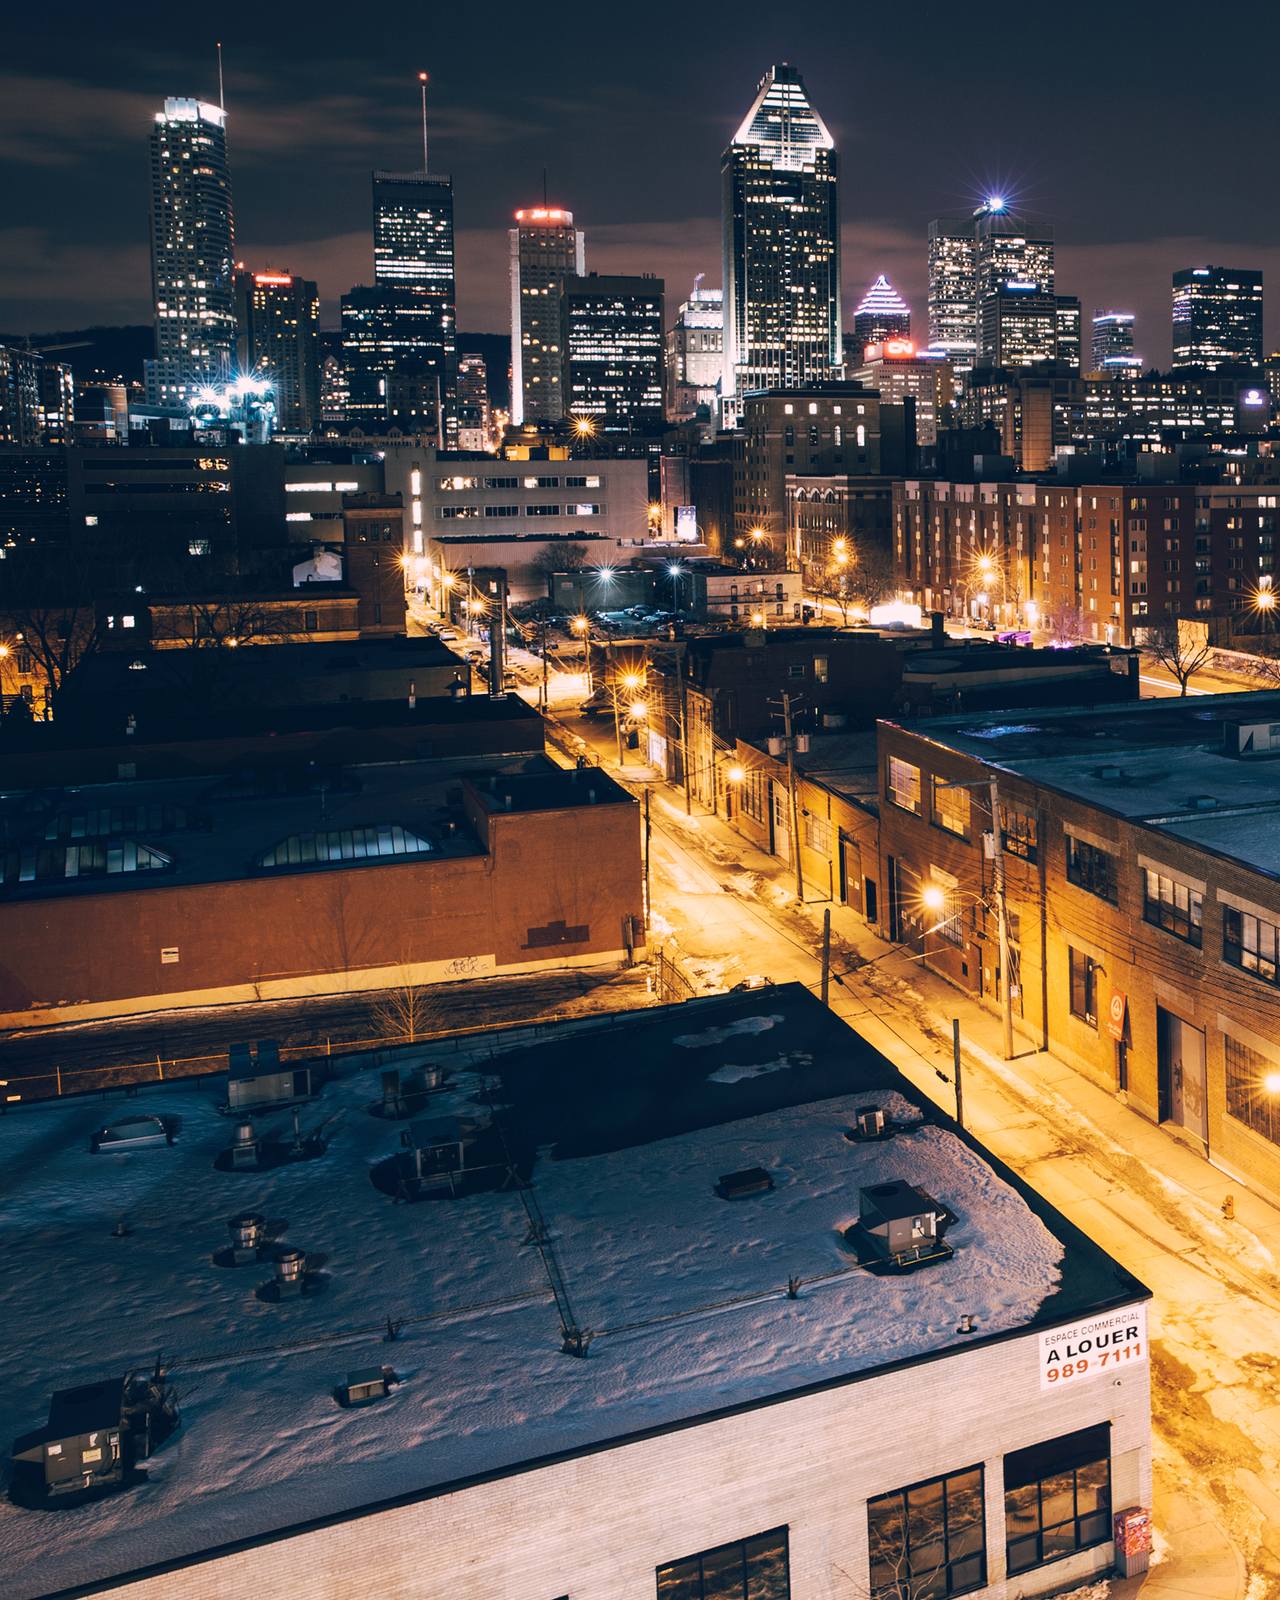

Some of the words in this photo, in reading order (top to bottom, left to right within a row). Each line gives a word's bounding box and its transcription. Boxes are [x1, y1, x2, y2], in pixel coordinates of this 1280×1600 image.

[888, 342, 913, 353] CN
[1045, 1329, 1078, 1346] ESPACE
[1081, 1312, 1140, 1336] COMMERCIAL
[1046, 1349, 1060, 1364] A
[1066, 1326, 1139, 1358] LOUER
